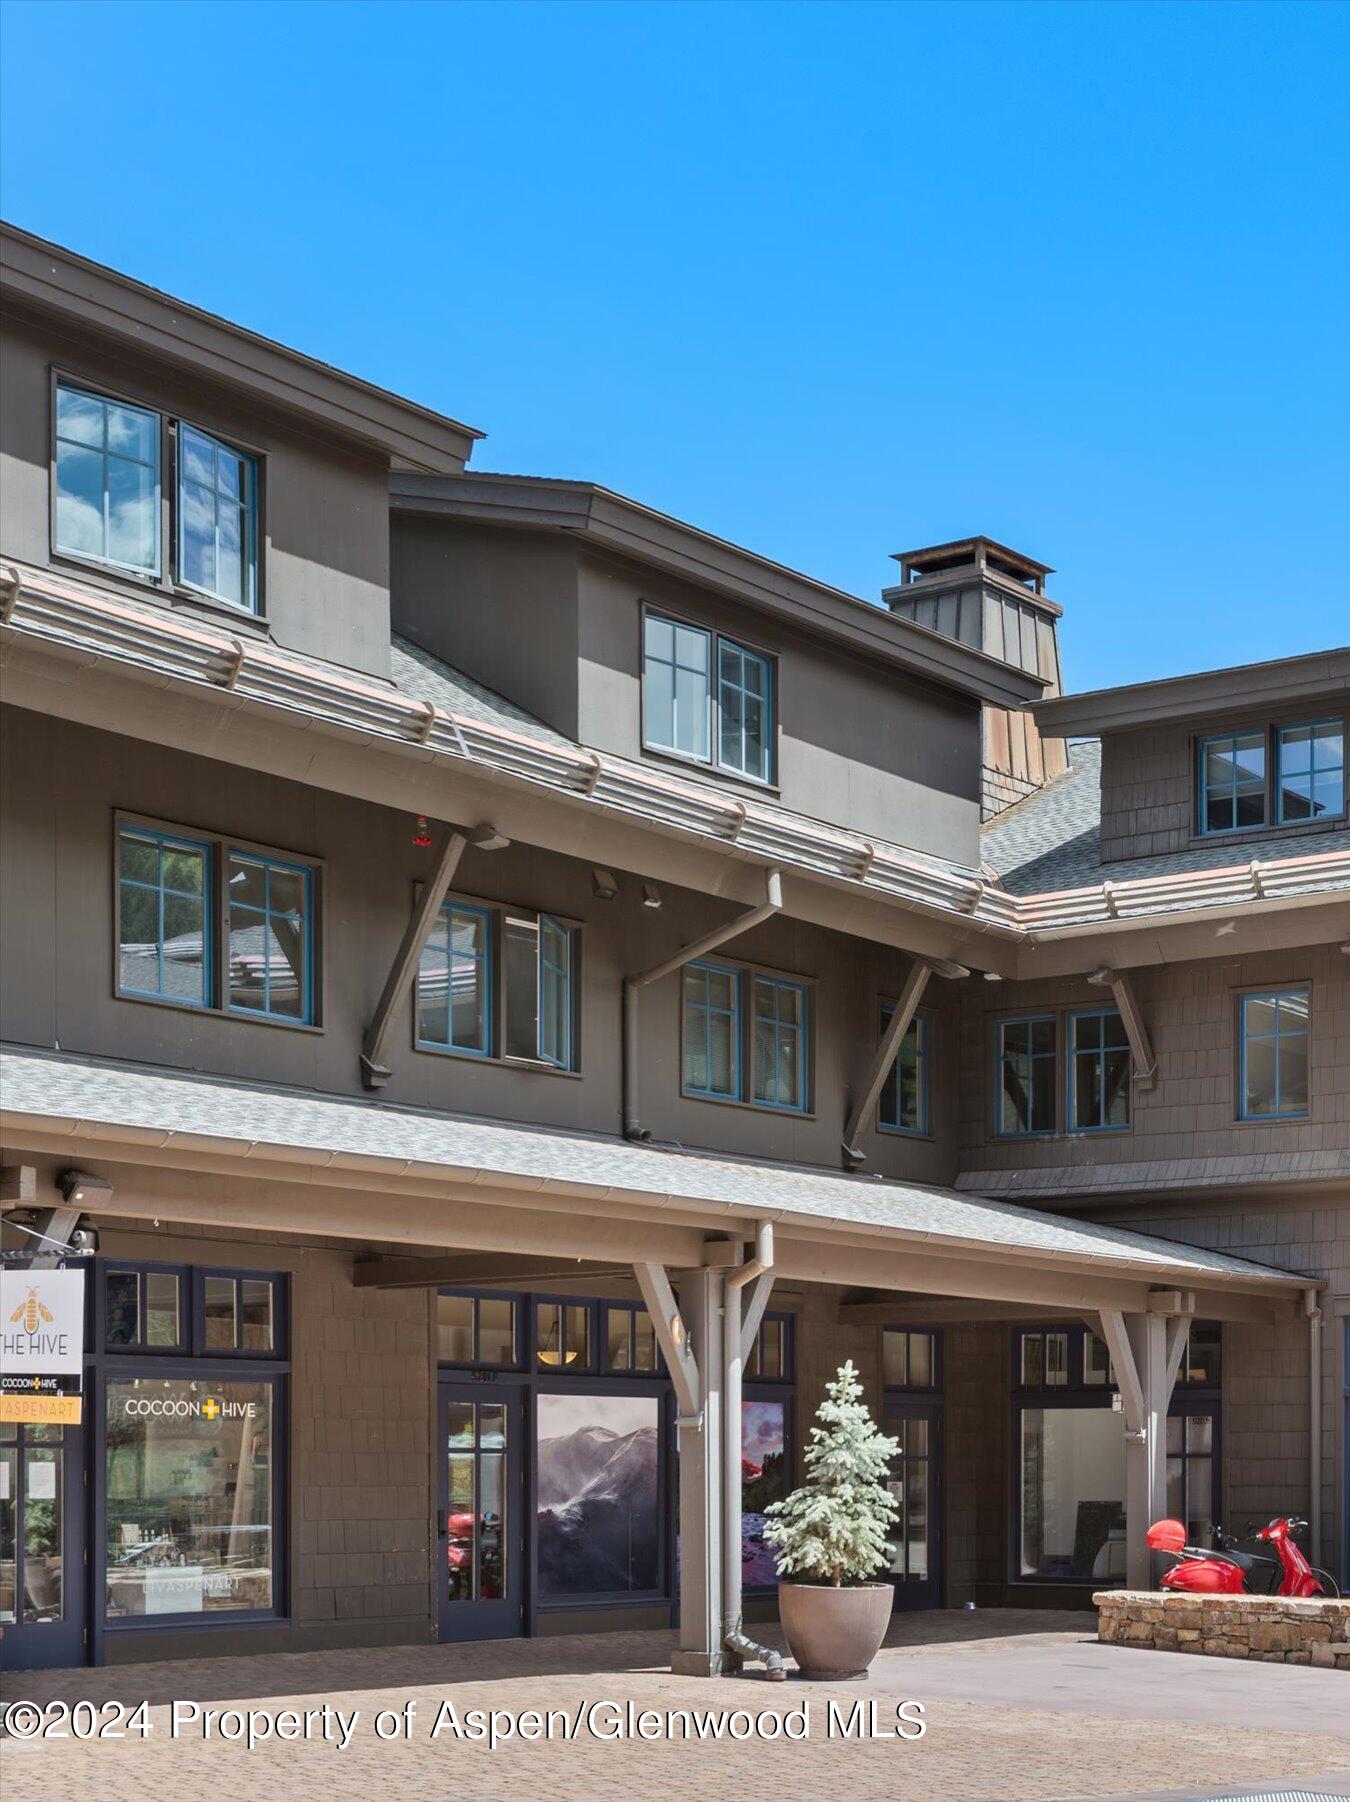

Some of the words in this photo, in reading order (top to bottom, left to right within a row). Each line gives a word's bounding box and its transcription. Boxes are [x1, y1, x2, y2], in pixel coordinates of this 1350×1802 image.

[29, 1334, 68, 1355] HIVE
[2, 1378, 33, 1388] COCOON
[41, 1379, 57, 1389] HIVE
[125, 1399, 199, 1416] COCOON
[222, 1402, 256, 1418] HIVE
